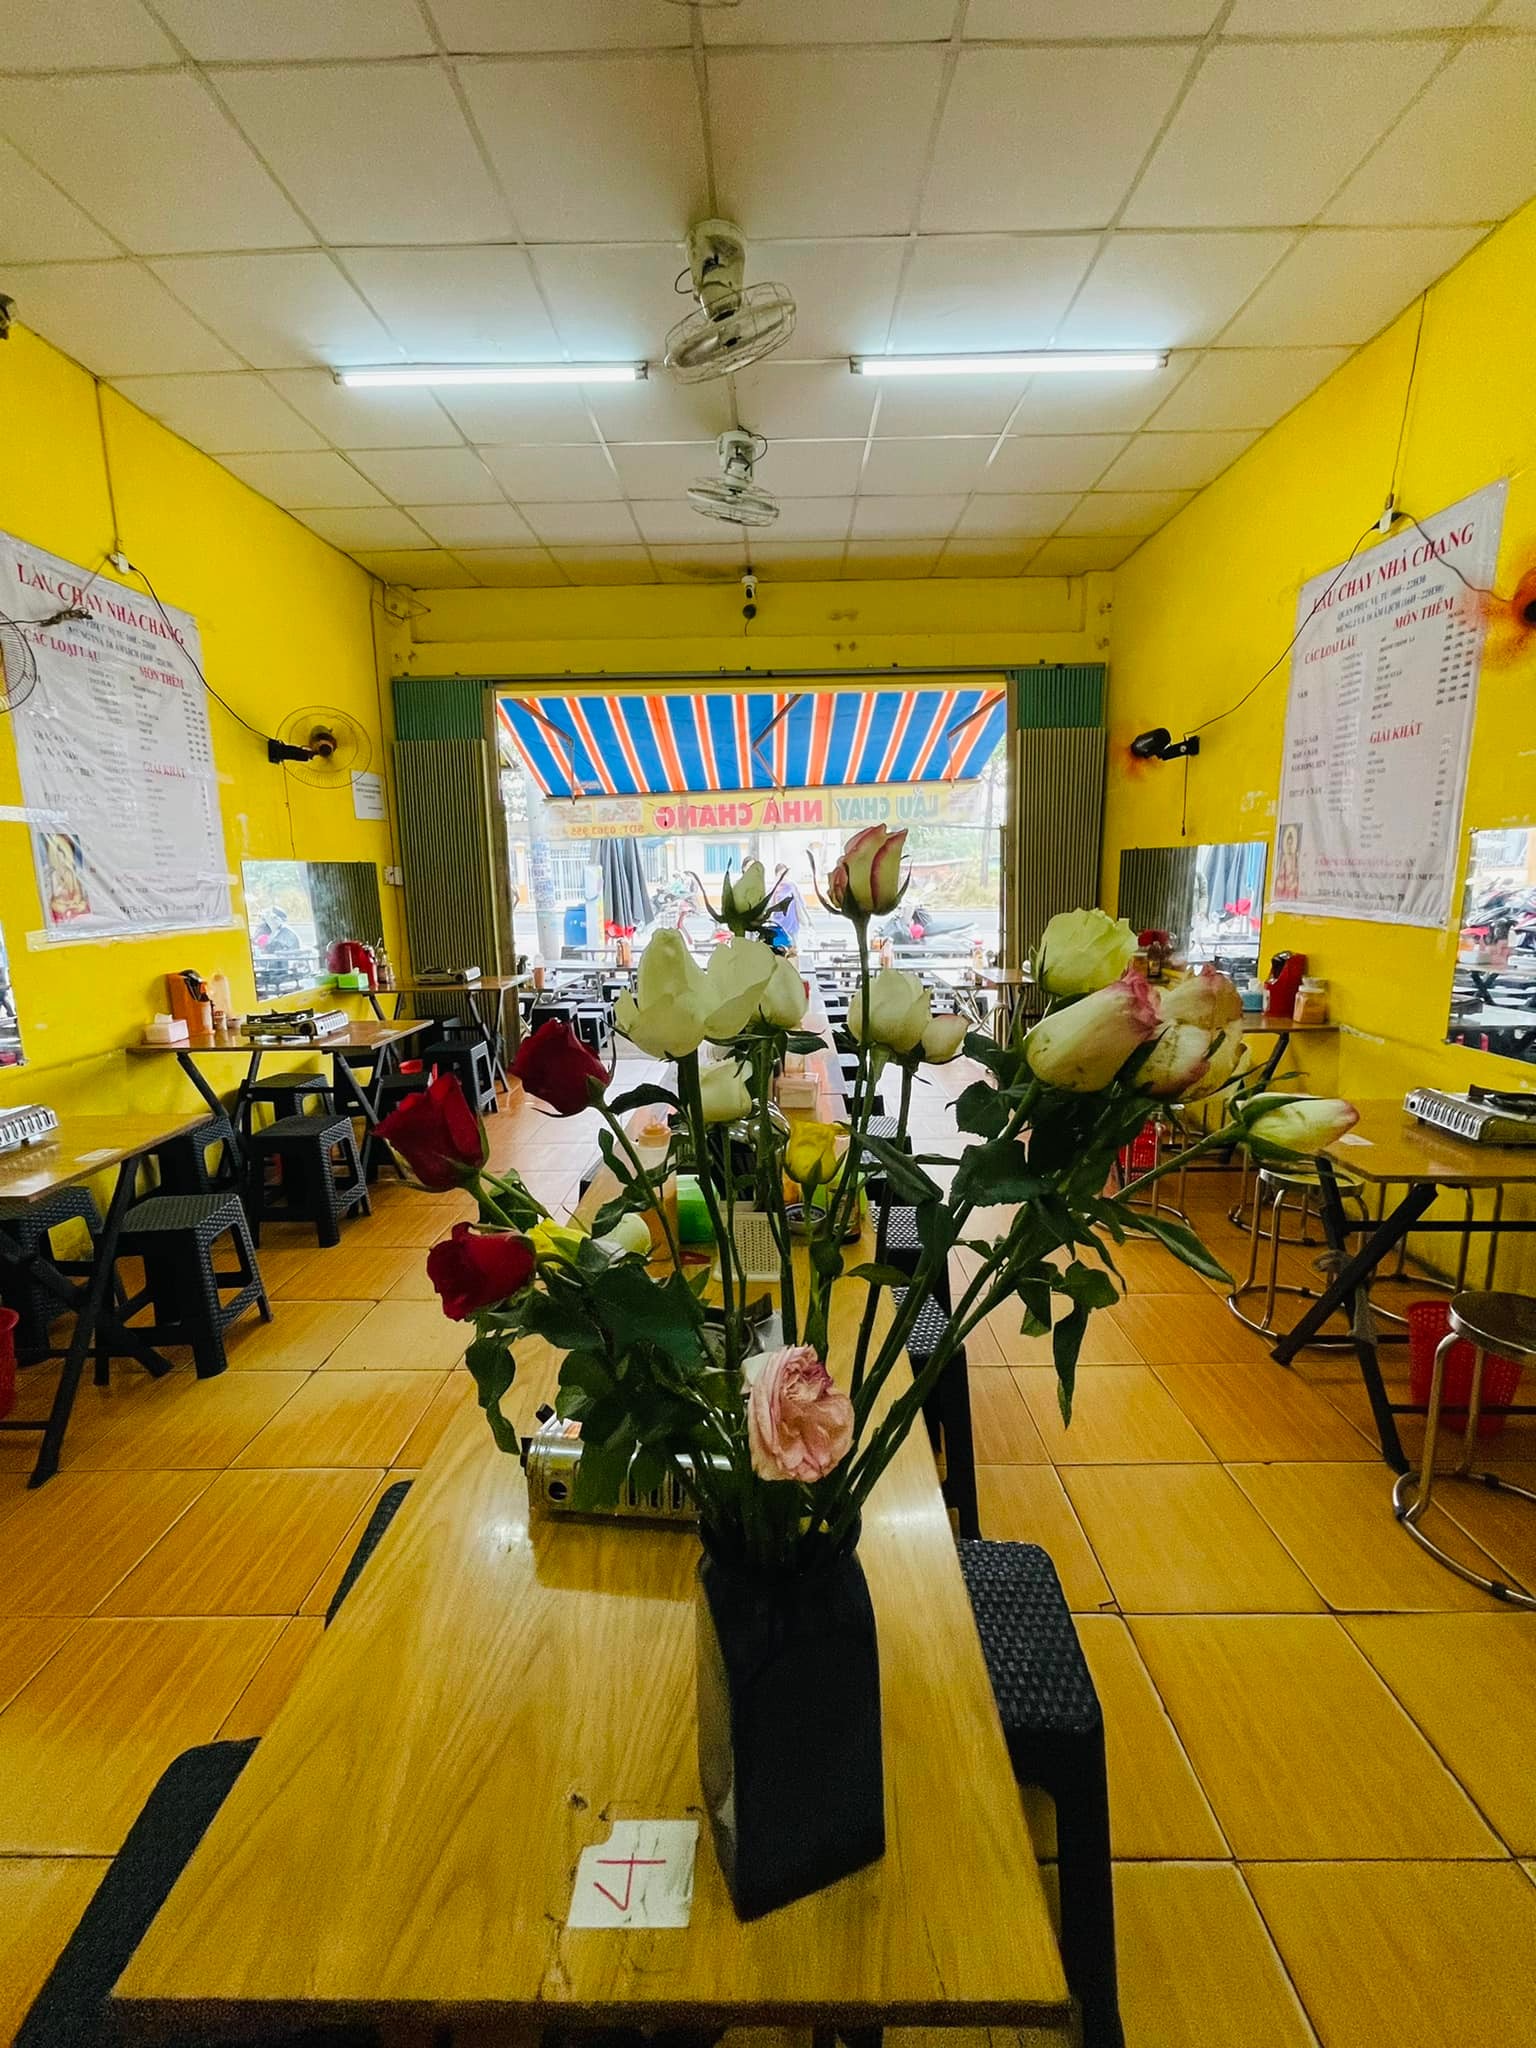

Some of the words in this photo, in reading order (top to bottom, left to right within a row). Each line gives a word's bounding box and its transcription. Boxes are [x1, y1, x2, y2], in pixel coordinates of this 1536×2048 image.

[1338, 568, 1376, 602] CHAY
[1412, 522, 1475, 568] CHANG
[57, 581, 103, 613] CHAY
[138, 613, 184, 645] CHANG
[1420, 596, 1455, 622] THÊM
